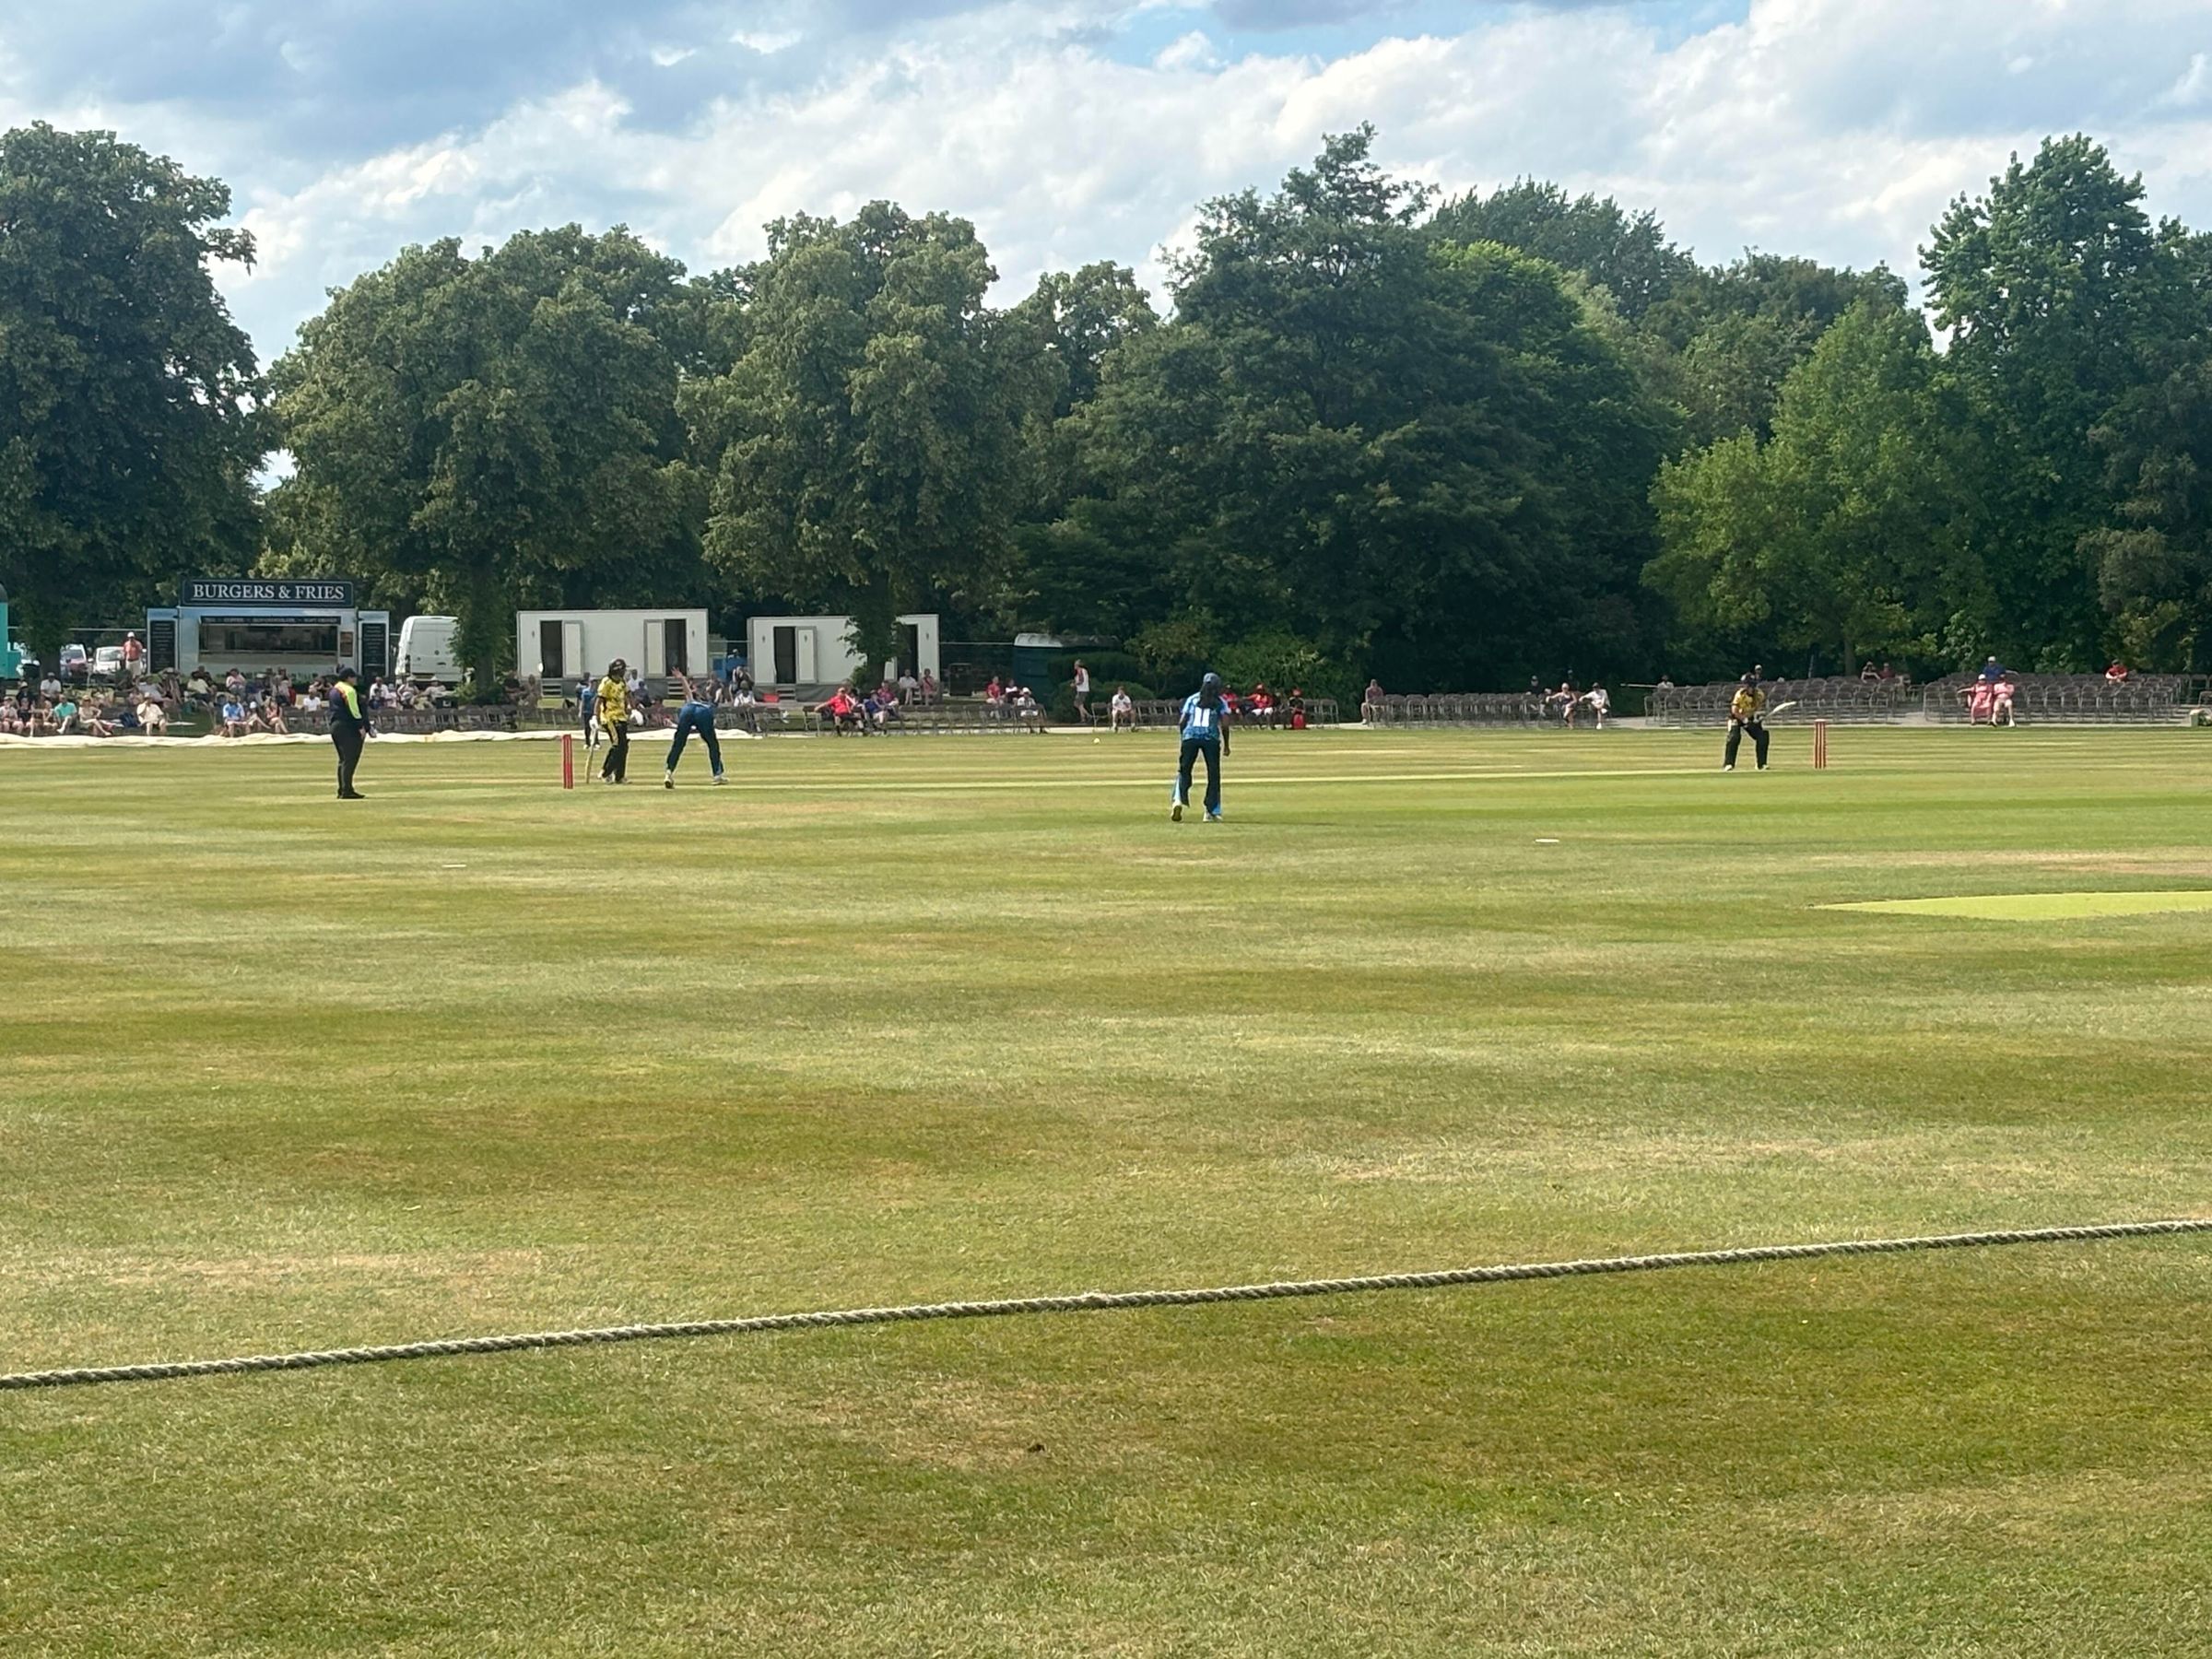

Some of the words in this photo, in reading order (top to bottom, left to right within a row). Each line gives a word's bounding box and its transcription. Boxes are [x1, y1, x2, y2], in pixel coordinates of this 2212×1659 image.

[194, 584, 275, 599] BURGERS
[278, 586, 291, 599] &
[295, 585, 345, 599] FRIES
[1193, 707, 1210, 727] 11
